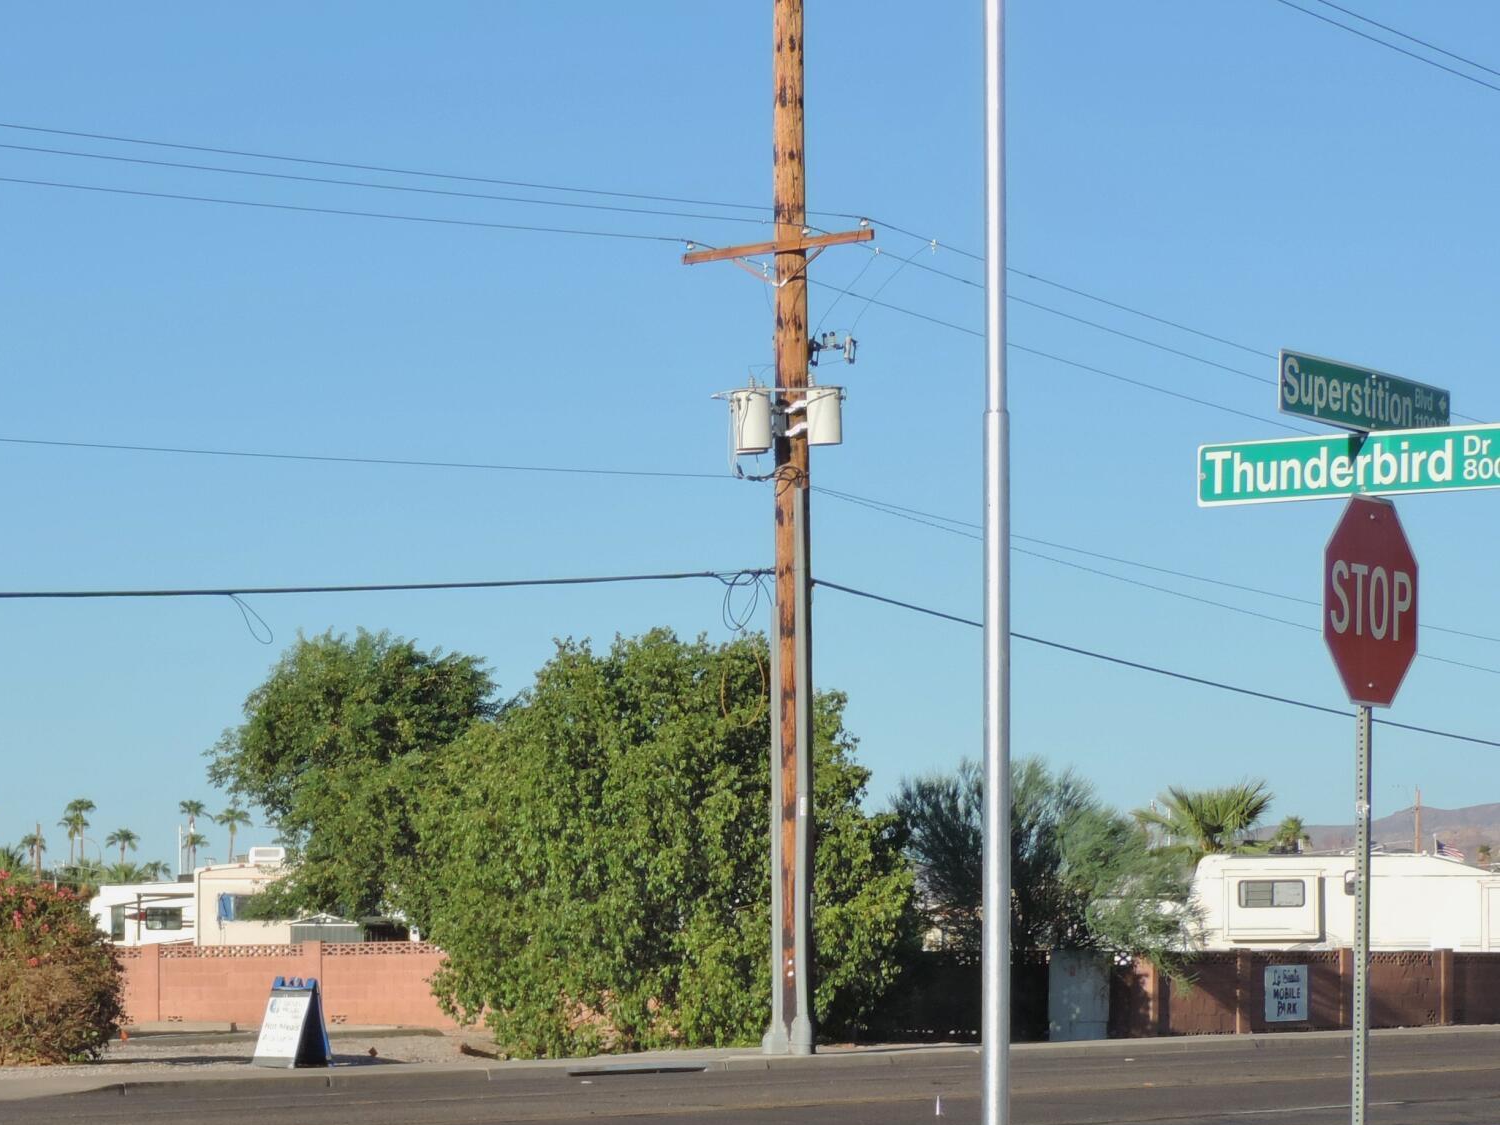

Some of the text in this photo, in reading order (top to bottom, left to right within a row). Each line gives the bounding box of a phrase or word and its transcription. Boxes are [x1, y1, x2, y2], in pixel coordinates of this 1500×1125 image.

[1283, 357, 1433, 427] Superstition Blvd
[1205, 435, 1491, 495] Thunderbird Dr
[1330, 560, 1411, 641] STOP
[1273, 987, 1300, 1000] MOBILE
[1277, 1001, 1298, 1017] PARK
